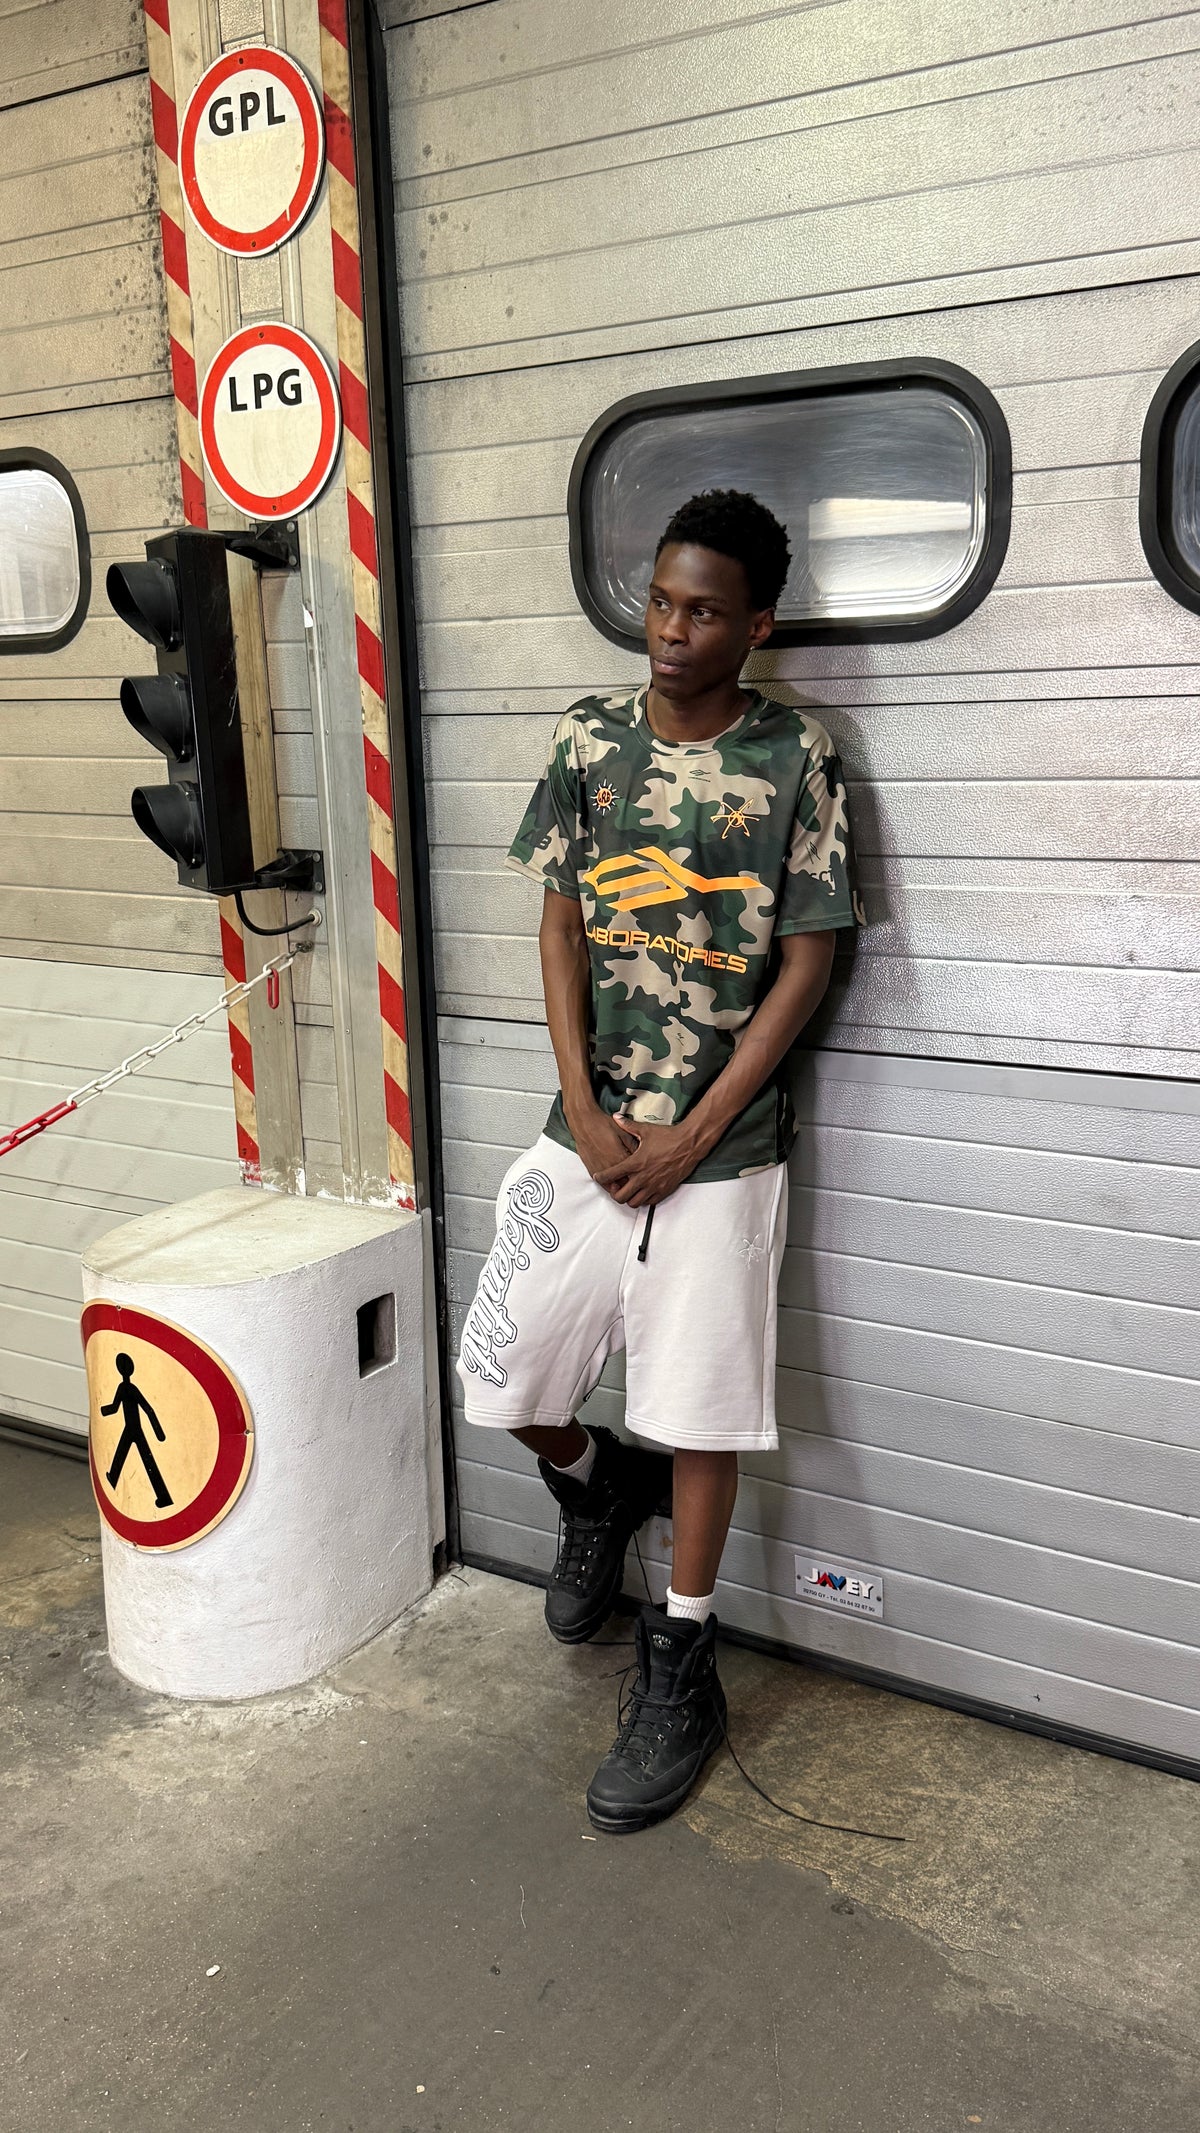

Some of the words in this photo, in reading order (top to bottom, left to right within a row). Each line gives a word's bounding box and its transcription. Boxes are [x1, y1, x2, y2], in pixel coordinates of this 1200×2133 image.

[208, 86, 286, 137] GPL
[228, 368, 303, 413] LPG
[804, 1568, 874, 1599] JAVEY
